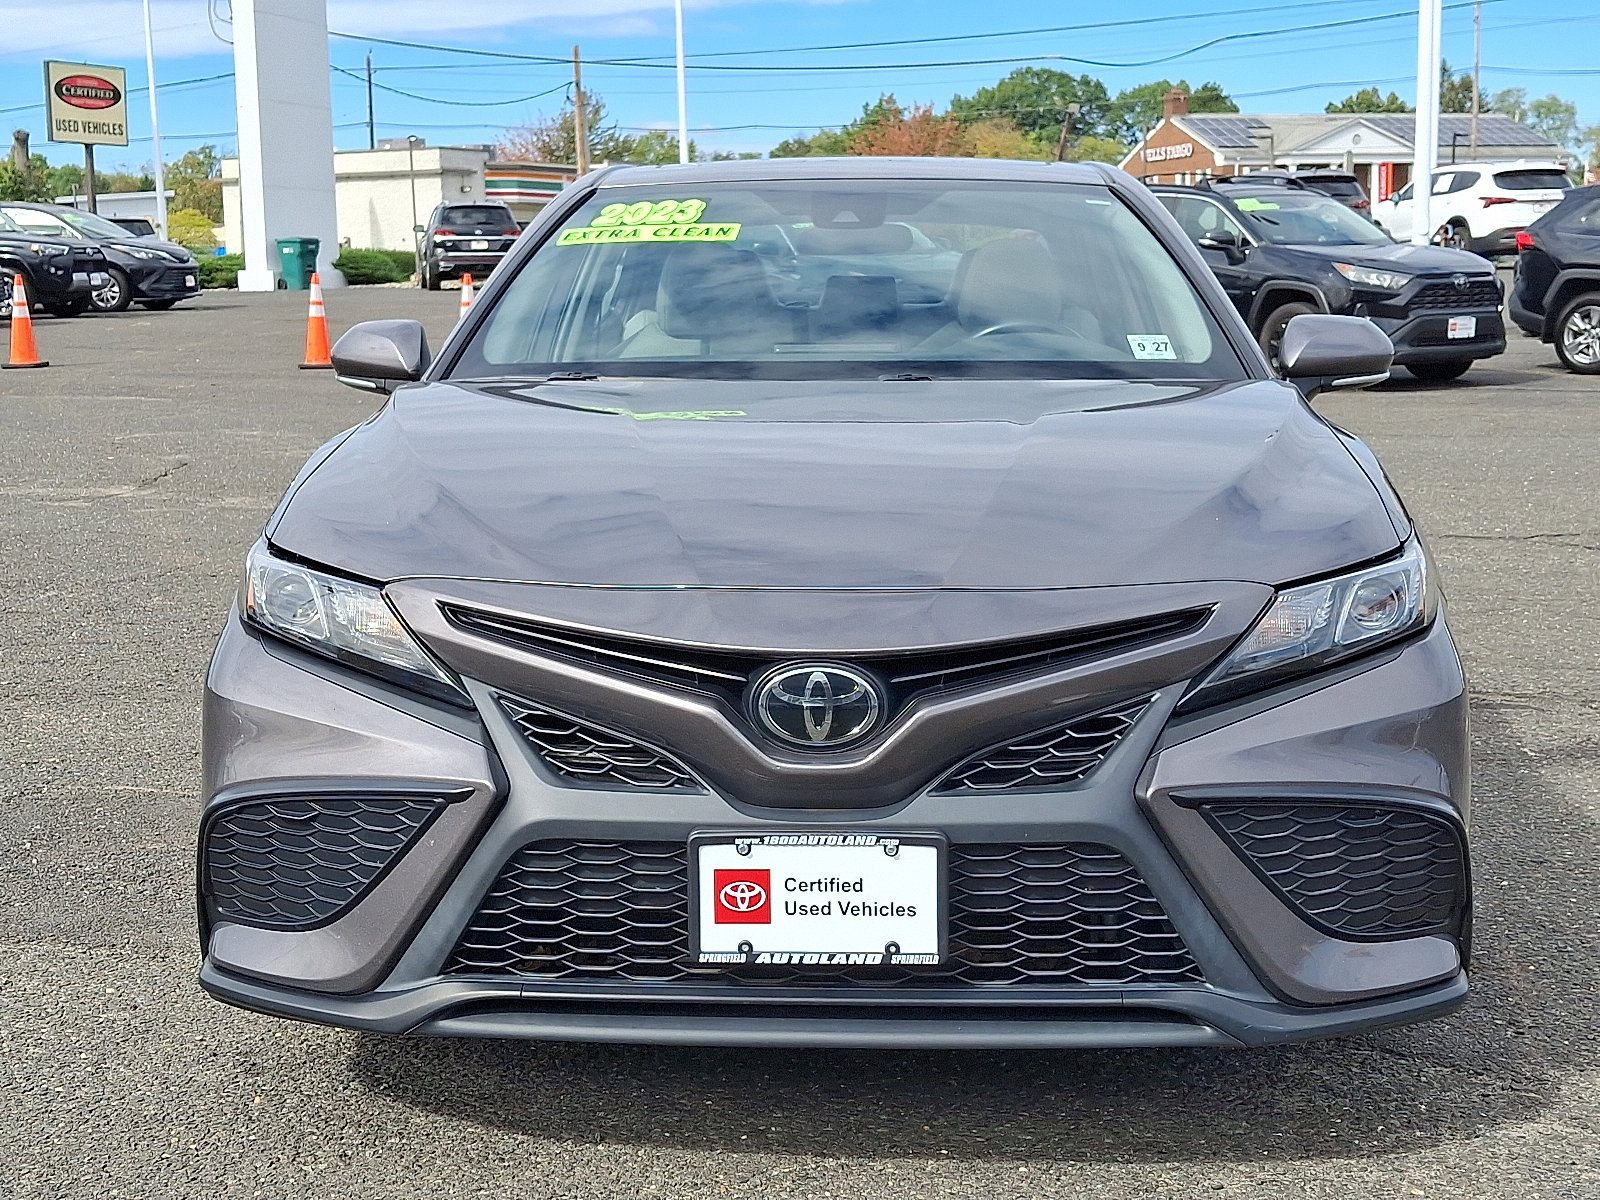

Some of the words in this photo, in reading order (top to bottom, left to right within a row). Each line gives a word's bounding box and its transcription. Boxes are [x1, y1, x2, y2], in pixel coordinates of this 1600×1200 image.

[62, 85, 114, 99] CERTIFIED
[55, 119, 79, 132] USED
[81, 120, 124, 136] VEHICLES
[591, 198, 707, 227] 2023
[563, 228, 641, 242] EXTRA
[652, 226, 736, 239] CLEAN
[1137, 342, 1146, 351] 9
[1152, 341, 1168, 351] 27
[784, 877, 863, 893] Certified
[785, 900, 831, 916] Used
[838, 900, 917, 917] Vehicles
[698, 952, 748, 964] SPRINGFIELD
[754, 953, 884, 965] AUTOLAND
[890, 954, 940, 966] SPRINGFIELD
